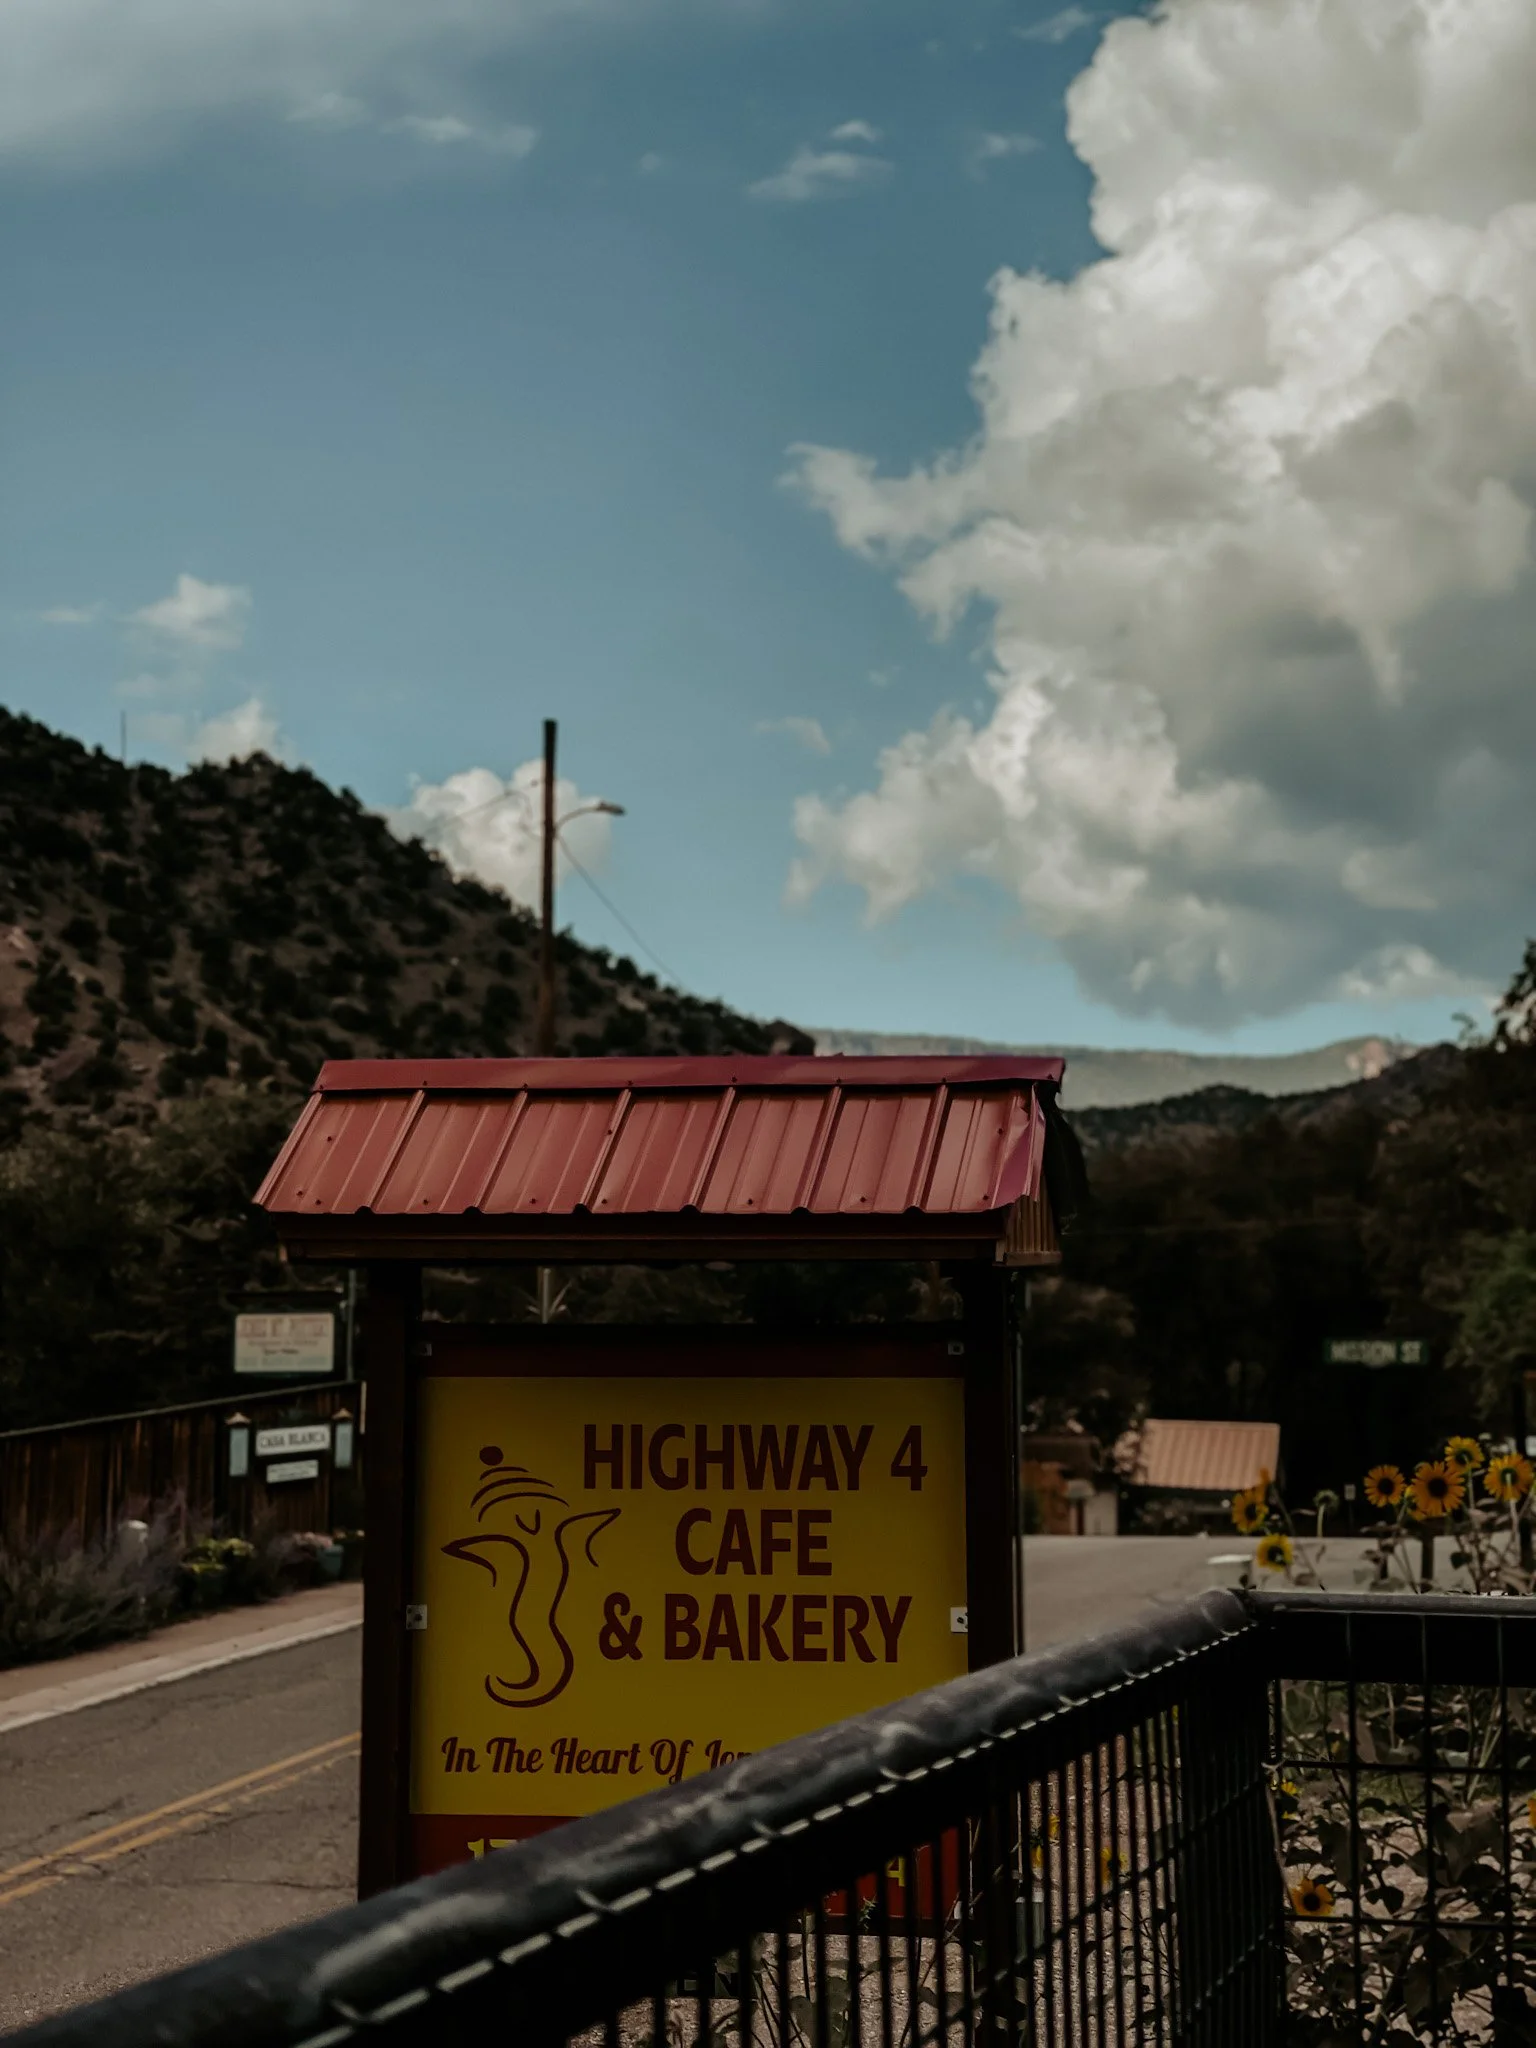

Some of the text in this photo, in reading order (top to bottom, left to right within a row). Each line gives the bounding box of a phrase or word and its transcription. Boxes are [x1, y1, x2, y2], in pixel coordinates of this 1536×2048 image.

[260, 1430, 326, 1449] CASA BLANCA
[584, 1424, 928, 1491] HIGHWAY 4
[676, 1508, 832, 1575] CAFE
[599, 1591, 912, 1663] & BAKERY
[441, 1737, 480, 1773] In
[486, 1737, 544, 1774] The
[551, 1738, 643, 1775] Heart
[650, 1739, 694, 1785] Of
